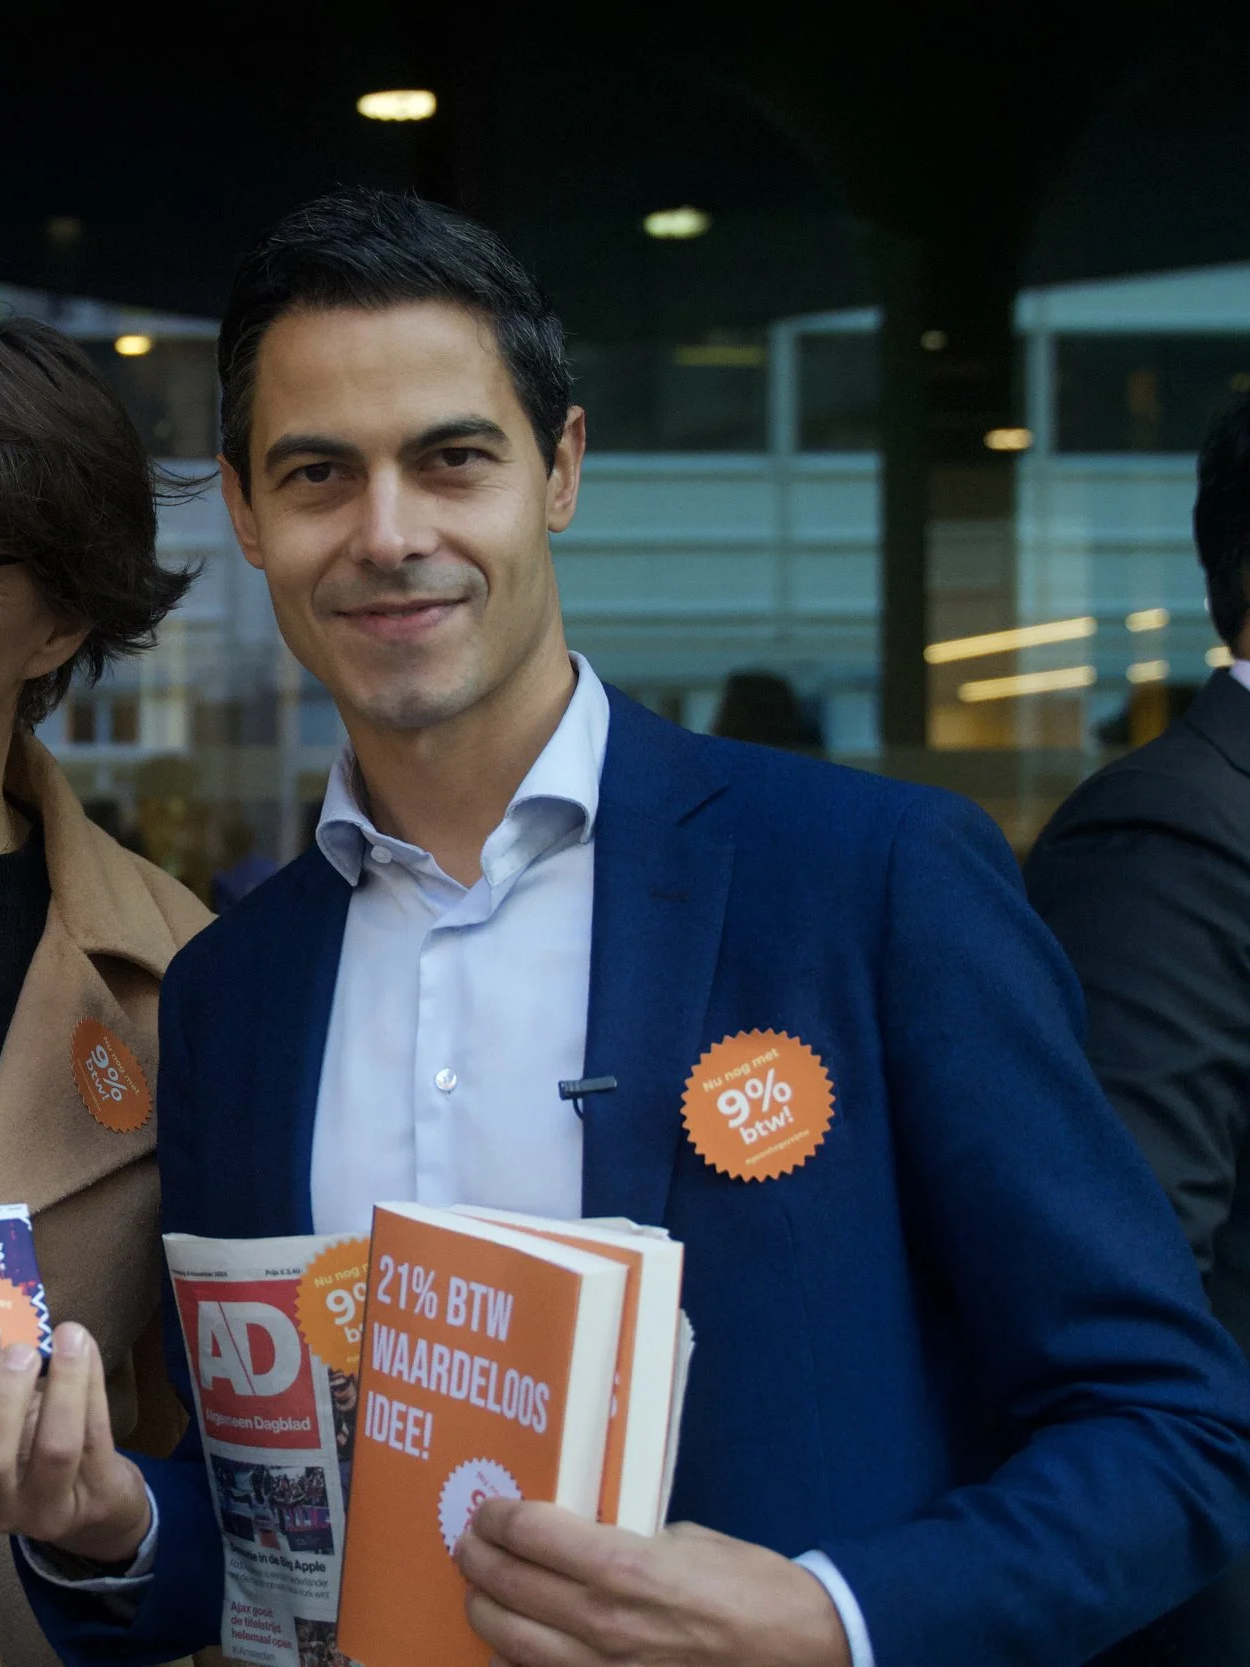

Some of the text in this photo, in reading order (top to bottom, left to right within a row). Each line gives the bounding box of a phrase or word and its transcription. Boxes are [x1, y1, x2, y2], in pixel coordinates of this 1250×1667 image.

[90, 1044, 128, 1102] 9%
[702, 1048, 780, 1092] Nu nog met
[716, 1067, 792, 1129] 9%
[738, 1104, 794, 1145] btw!
[314, 1276, 333, 1288] Nu
[334, 1266, 360, 1281] nog
[376, 1254, 514, 1342] 21% BTW
[198, 1301, 302, 1397] AD
[371, 1322, 550, 1435] WAARDELOOS
[254, 1416, 312, 1434] Dagblad
[364, 1390, 433, 1461] IDEE!
[295, 1559, 326, 1574] Apple
[230, 1600, 252, 1614] Ajax
[230, 1614, 243, 1626] de
[231, 1627, 293, 1650] helemaal open
